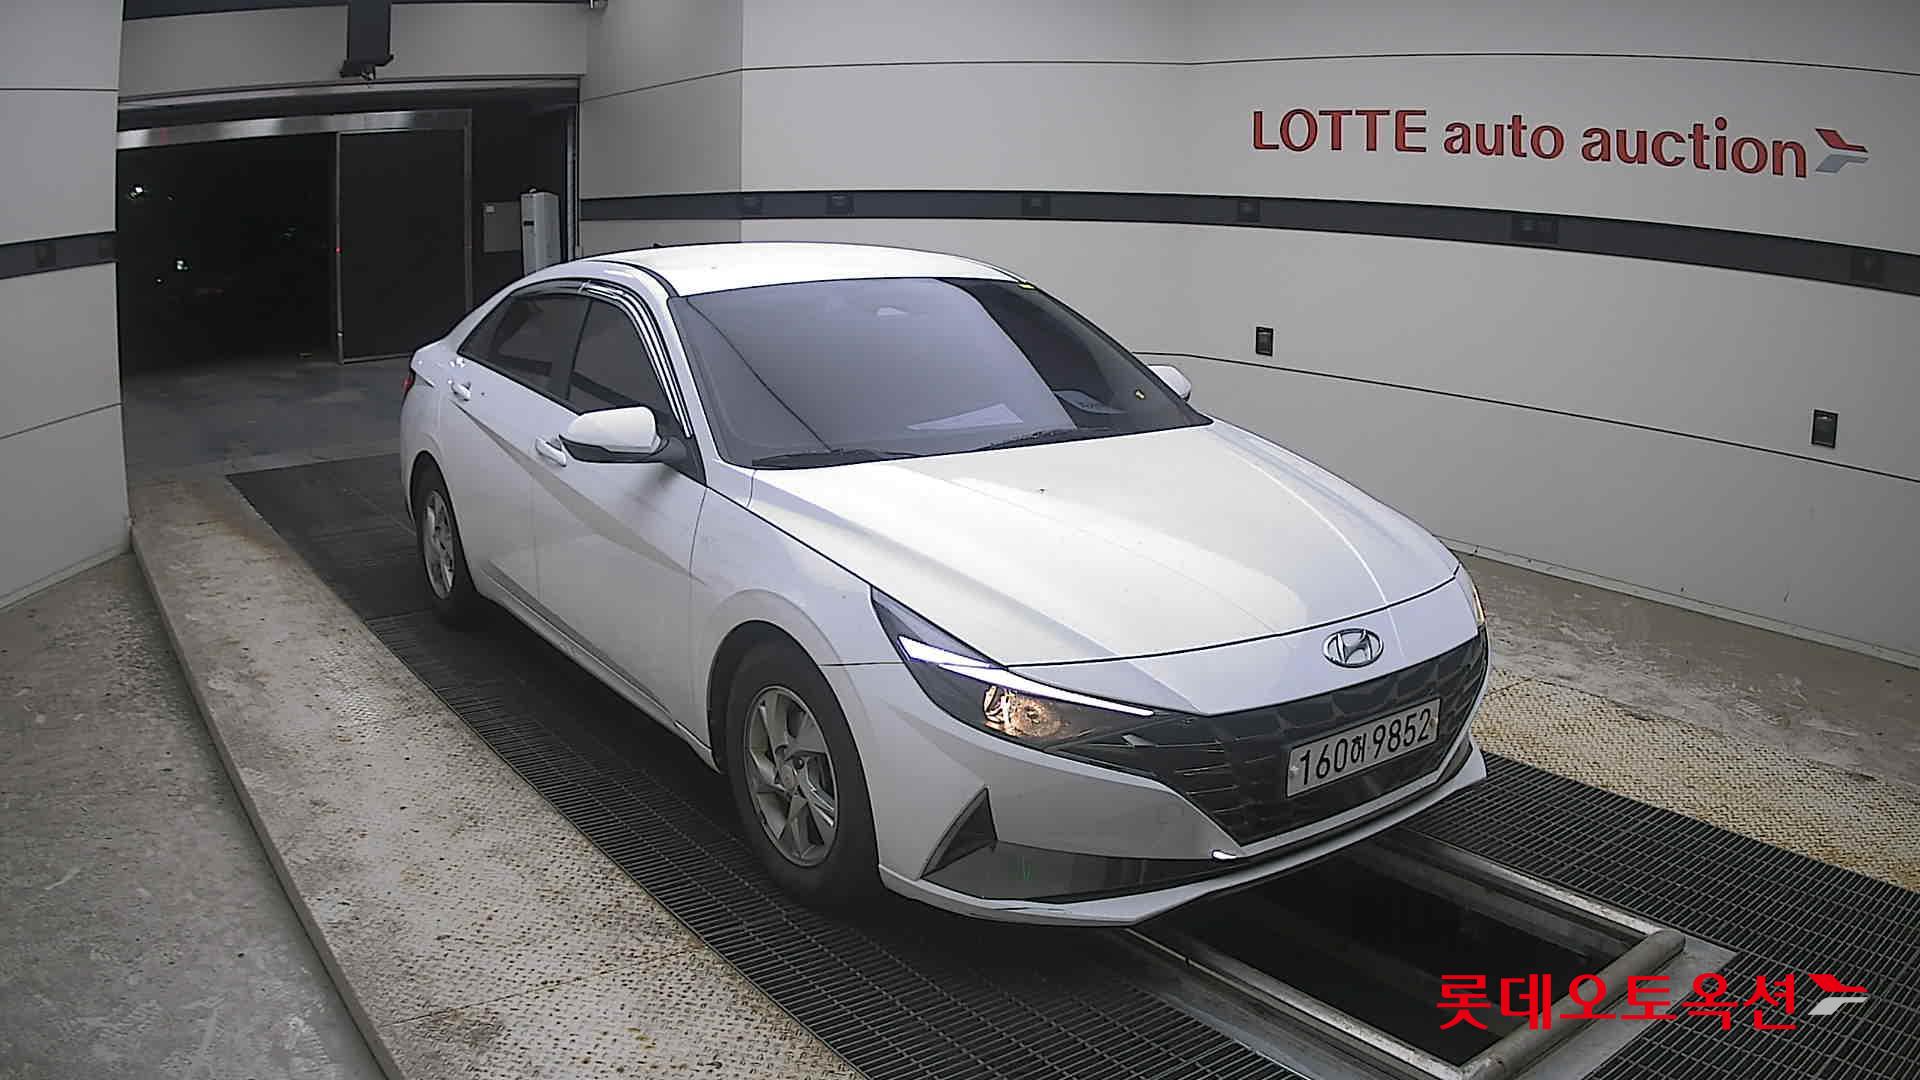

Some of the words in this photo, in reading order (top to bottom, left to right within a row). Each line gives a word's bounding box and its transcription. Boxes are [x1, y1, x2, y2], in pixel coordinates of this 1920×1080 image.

[1252, 109, 1428, 153] LOTTE
[1444, 115, 1565, 159] auto
[1581, 117, 1808, 179] auction
